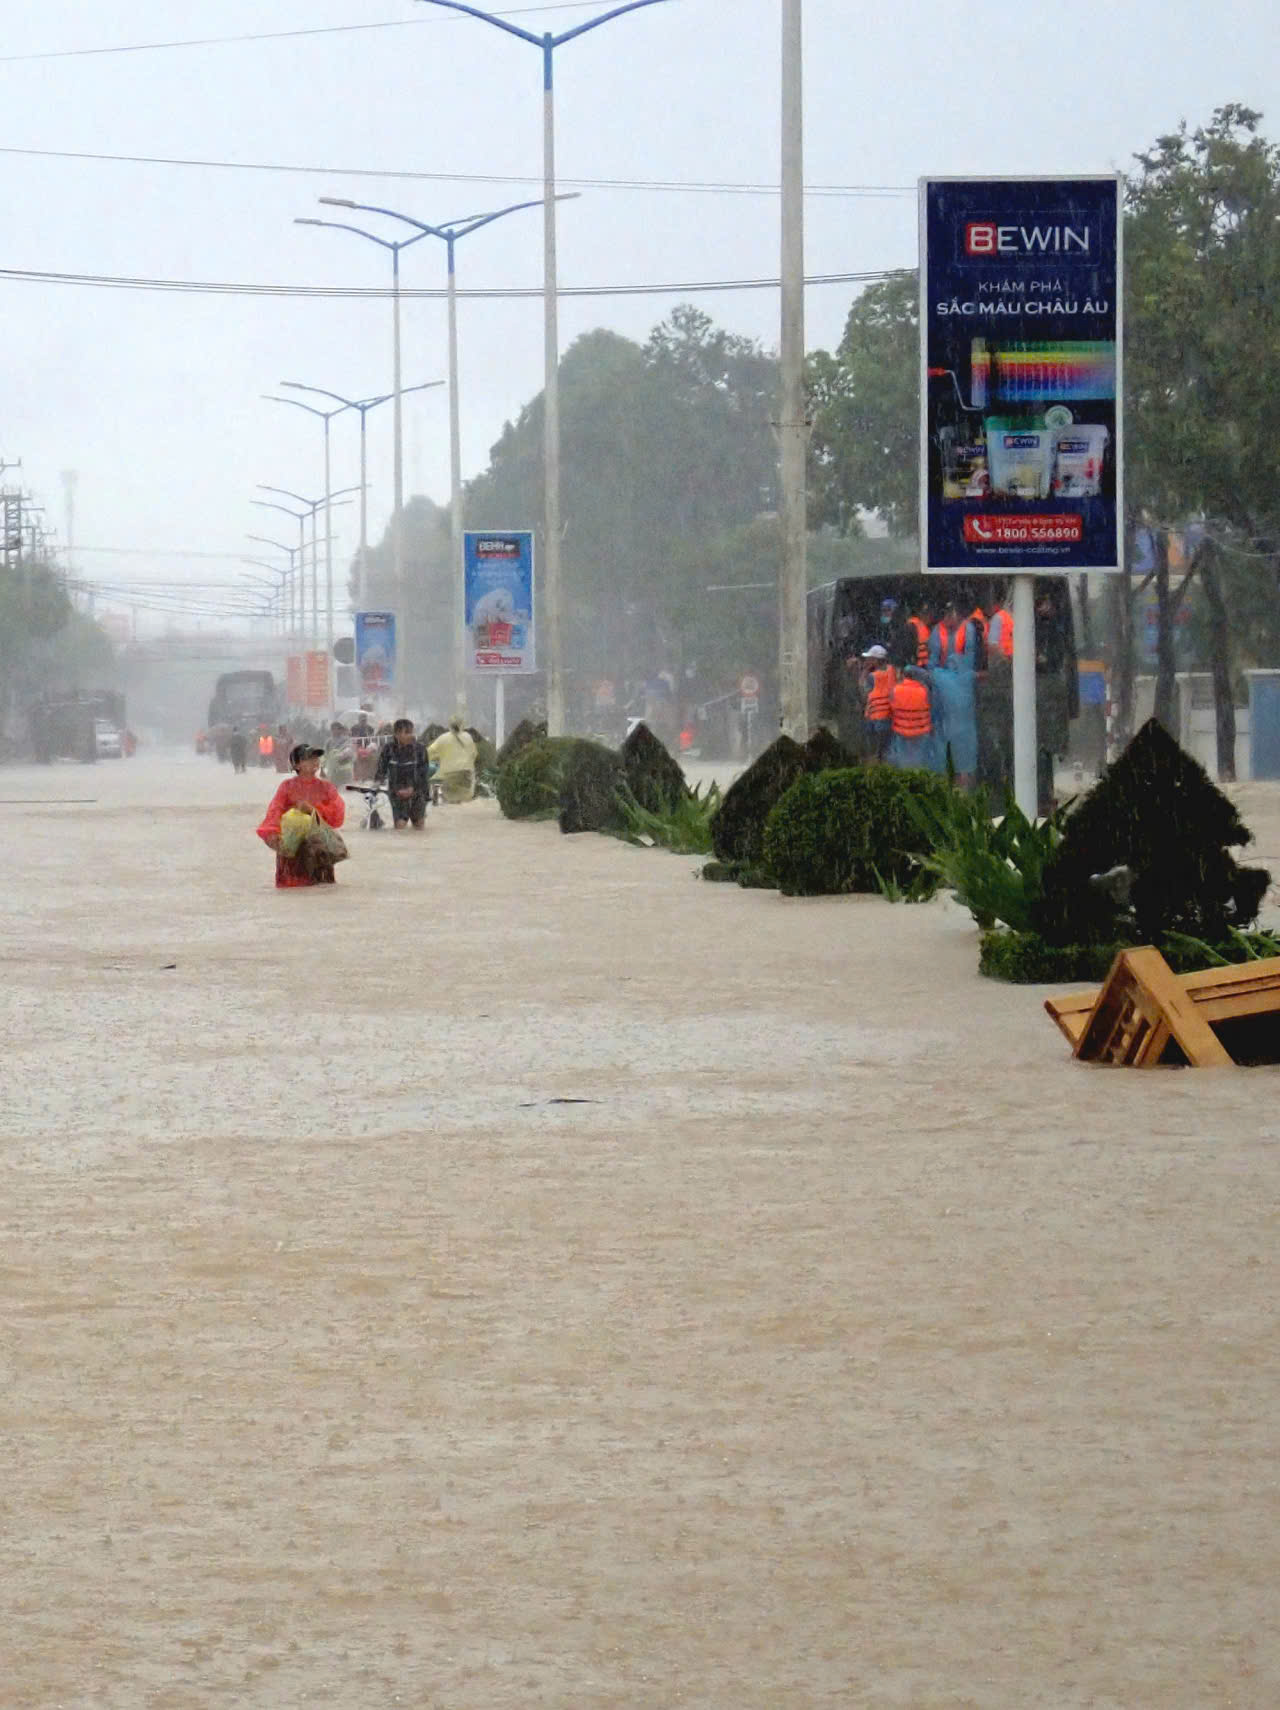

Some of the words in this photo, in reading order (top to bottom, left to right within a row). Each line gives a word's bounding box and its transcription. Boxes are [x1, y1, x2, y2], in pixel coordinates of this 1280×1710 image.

[969, 225, 1090, 252] BEWIN
[1024, 298, 1078, 315] CHÂU
[1081, 297, 1109, 315] ÂU
[996, 527, 1027, 539] 1800
[1031, 527, 1080, 539] 556890
